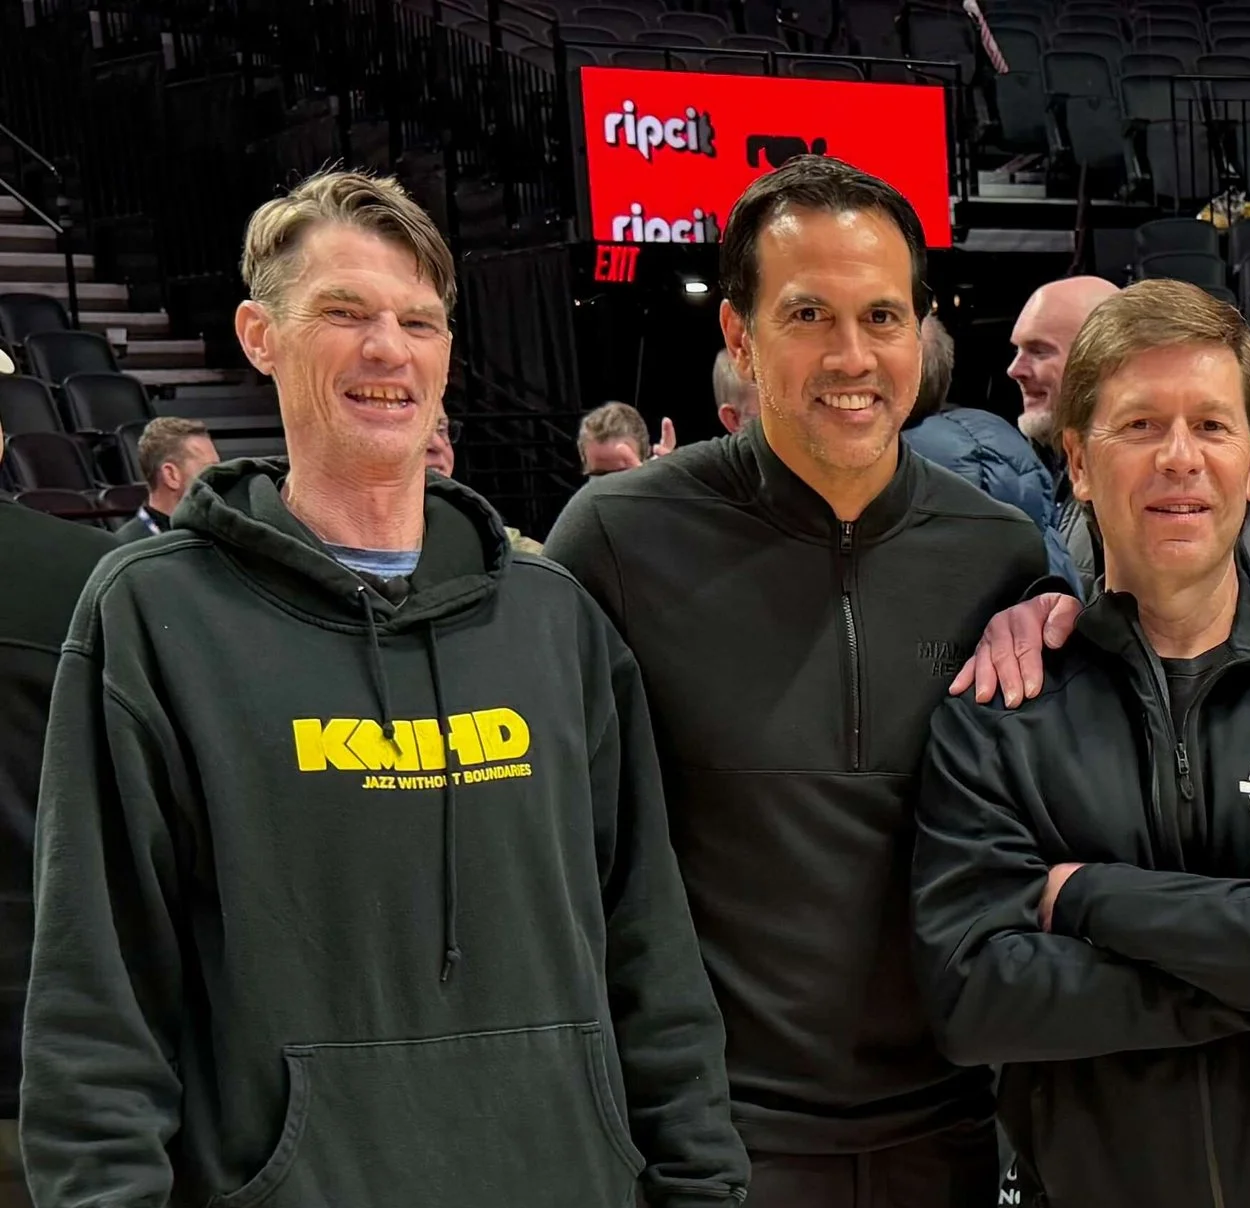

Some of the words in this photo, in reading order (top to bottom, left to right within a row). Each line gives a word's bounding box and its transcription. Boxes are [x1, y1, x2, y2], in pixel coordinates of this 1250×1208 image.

[595, 245, 640, 282] EXIT
[292, 707, 531, 771] KMHD
[362, 775, 396, 790] JAZZ
[397, 772, 462, 790] WITHOT
[463, 763, 533, 784] BOUNDARIES
